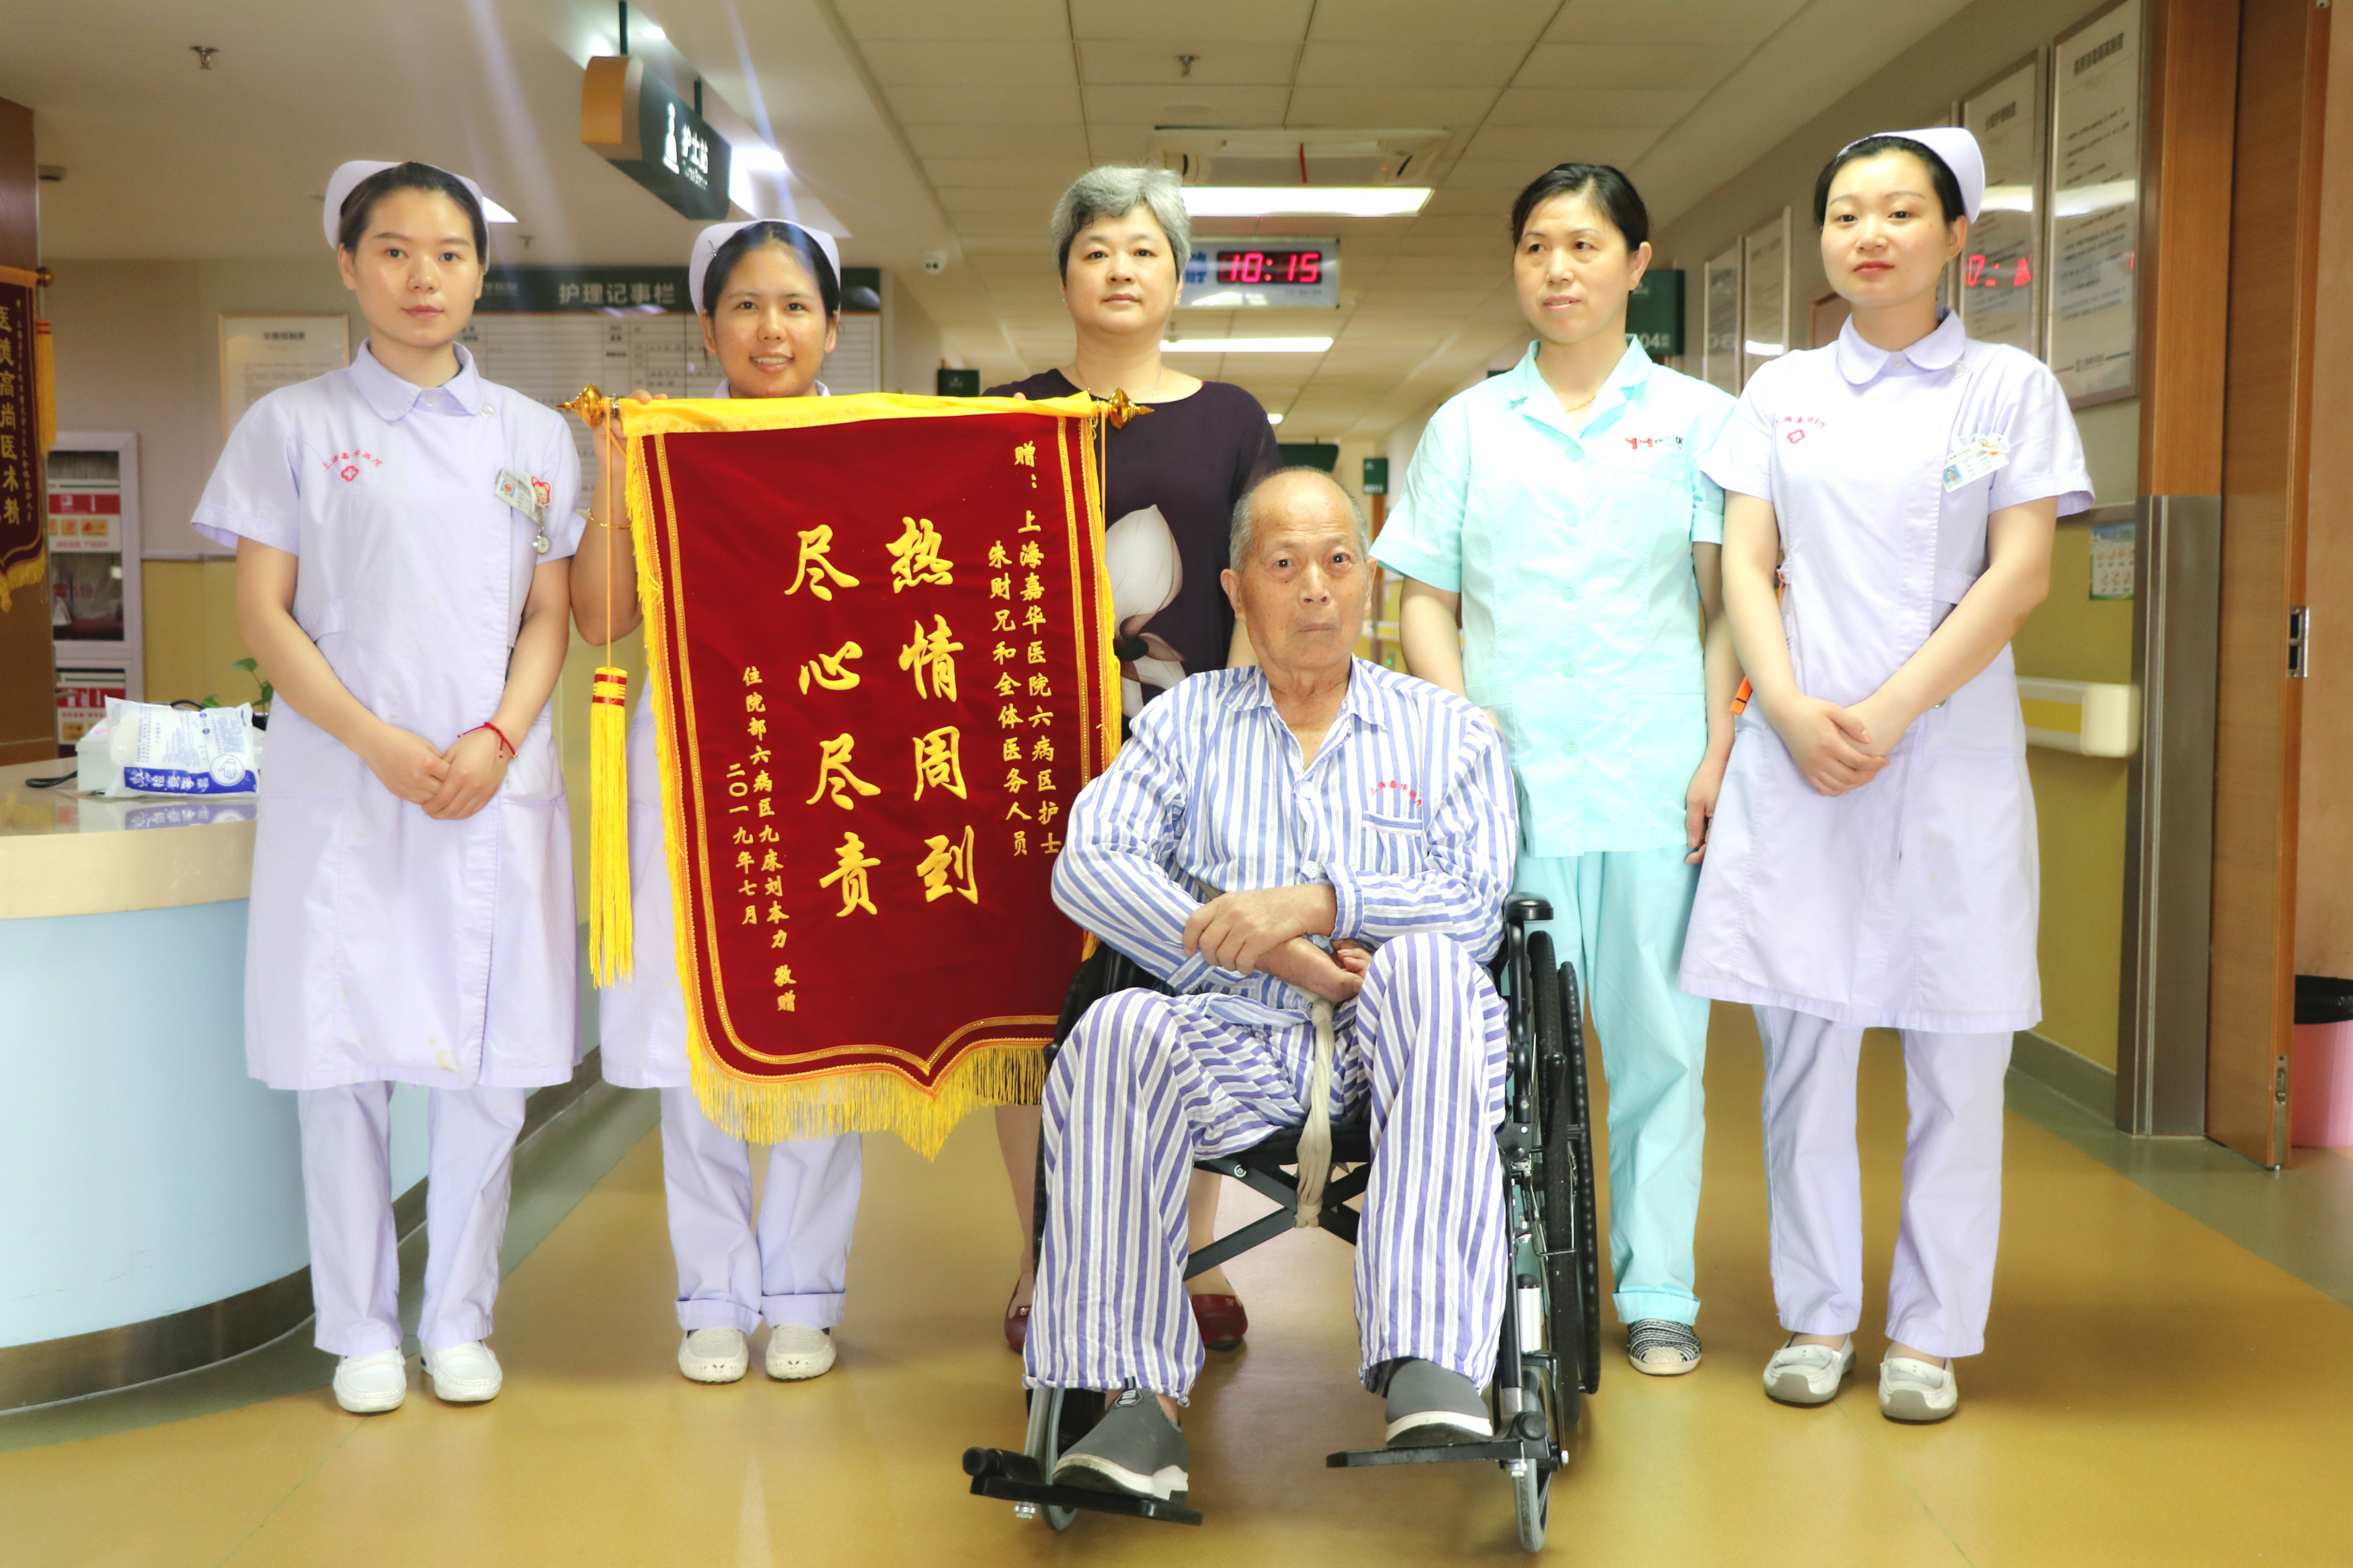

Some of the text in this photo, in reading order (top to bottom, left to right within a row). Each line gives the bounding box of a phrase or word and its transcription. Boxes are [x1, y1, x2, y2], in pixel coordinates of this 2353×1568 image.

[681, 123, 708, 174] 护士站
[559, 282, 675, 304] 护理记事栏
[1231, 253, 1319, 282] 10:15
[784, 524, 881, 917] 尽心尽责
[885, 516, 978, 905] 热情周到
[988, 540, 1033, 857] 朱财兄和全体医务人员
